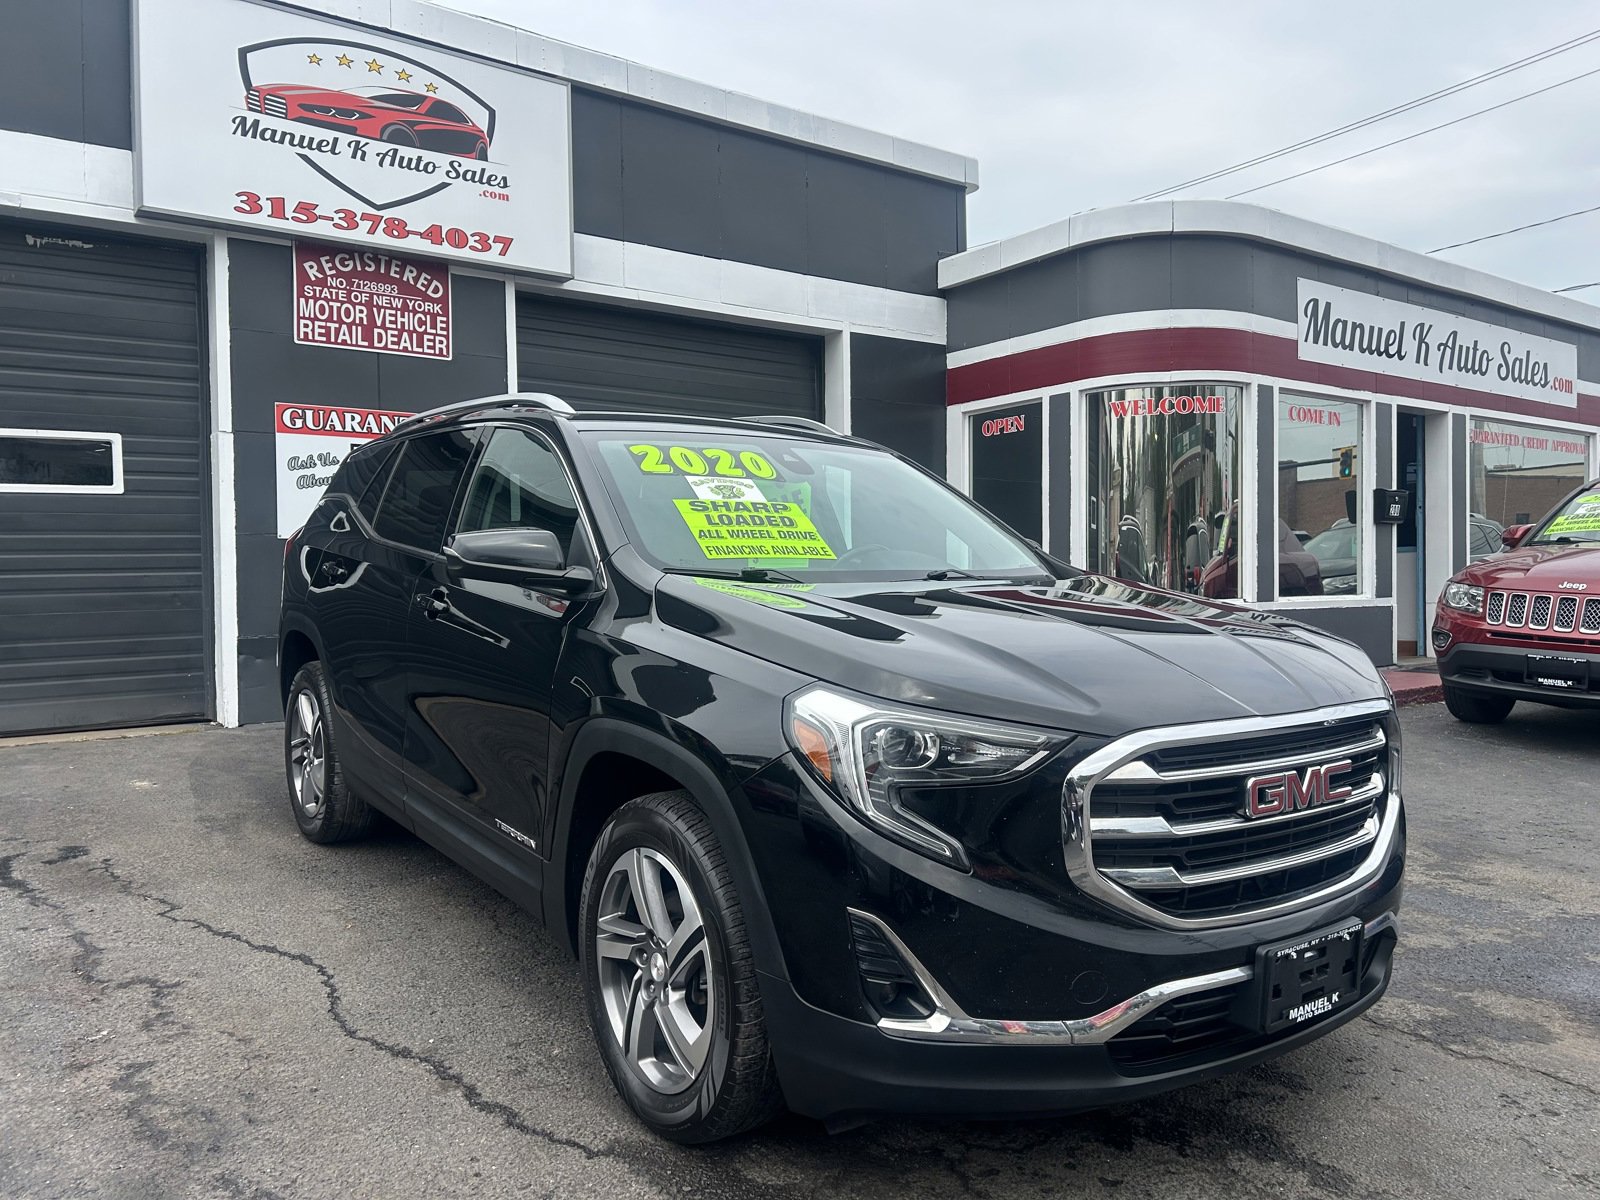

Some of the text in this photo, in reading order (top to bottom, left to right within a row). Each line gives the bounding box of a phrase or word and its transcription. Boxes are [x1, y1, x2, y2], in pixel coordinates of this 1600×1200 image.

[231, 115, 511, 189] Manuel K Auto Sales
[479, 190, 510, 201] .com
[233, 191, 514, 256] 315-378-4037
[303, 252, 444, 298] REGISTERED
[327, 276, 398, 294] NO. 7126993
[304, 285, 443, 314] STATE OF NEW YORK
[299, 297, 448, 335] MOTOR VEHICLE
[299, 319, 448, 355] RETAIL DEALER
[1303, 297, 1407, 361] Manuel
[1412, 322, 1433, 366] K
[1436, 330, 1494, 376] Auto
[1110, 396, 1226, 418] WELCOME
[1288, 405, 1341, 426] COME IN
[281, 407, 409, 435] GUARAN
[982, 415, 1025, 437] OPEN
[1523, 436, 1549, 451] CREDIT
[287, 452, 340, 471] Ask Us
[628, 444, 777, 480] 2020
[296, 473, 335, 489] Abou
[688, 500, 792, 513] SHARP
[705, 514, 798, 528] LOADED
[698, 529, 817, 541] ALL WHEEL DRIVE
[705, 545, 831, 557] FINANCING AVAILABLE
[1558, 581, 1587, 590] Jeep
[1246, 759, 1352, 819] GMC
[1311, 938, 1320, 946] NY
[1289, 991, 1340, 1020] MANUEL K
[1296, 1004, 1332, 1023] AUTO SALES
